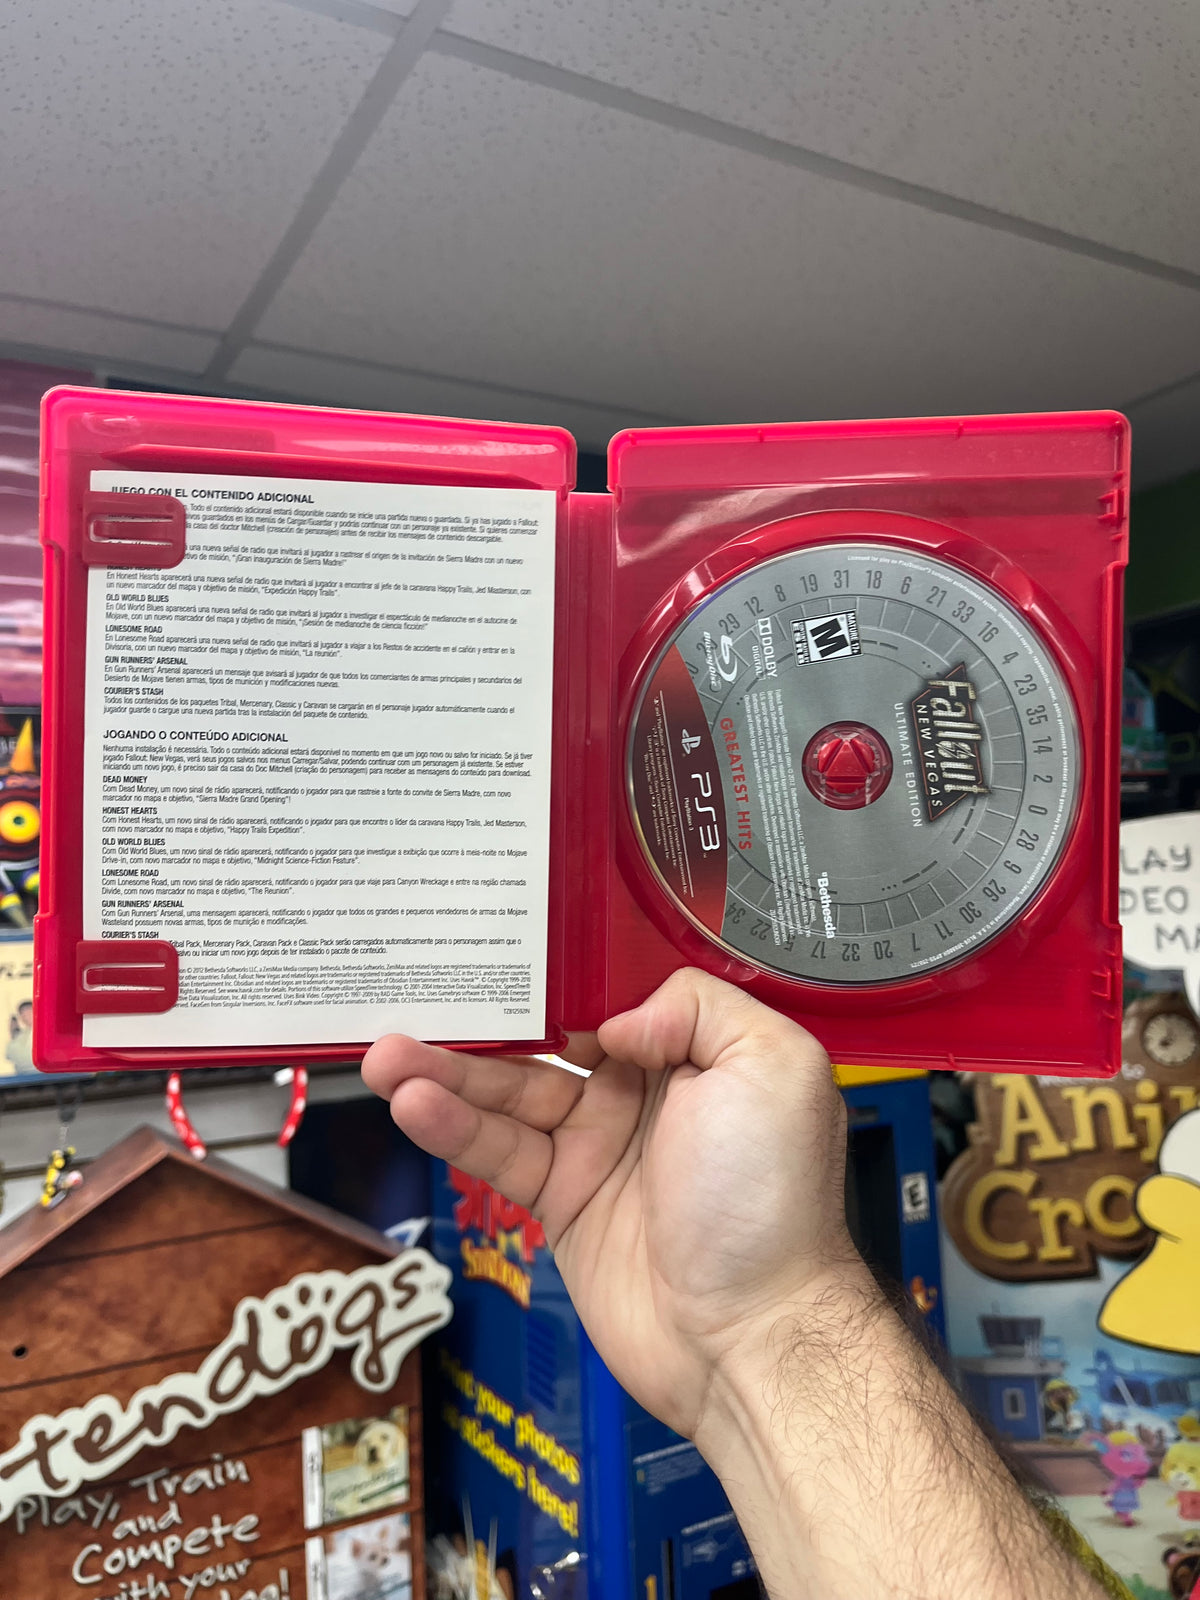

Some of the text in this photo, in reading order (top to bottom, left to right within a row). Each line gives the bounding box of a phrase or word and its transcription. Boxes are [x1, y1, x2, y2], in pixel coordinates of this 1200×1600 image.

[110, 486, 315, 504] JUEGO CON EL CONTENIDO ADICIONAL
[800, 573, 819, 594] 19
[833, 569, 850, 589] 31
[865, 570, 883, 590] 18
[900, 576, 912, 595] 6
[105, 593, 169, 603] OLD WORLD BLUES
[774, 584, 787, 602] 8
[926, 585, 948, 608] 21
[743, 596, 764, 617] 12
[952, 600, 975, 624] 33
[104, 624, 163, 634] LONESOME ROAD
[718, 612, 741, 635] 29
[846, 612, 861, 654] MATURE 17+
[978, 621, 999, 643] 16
[809, 617, 849, 658] M
[104, 655, 119, 664] GUN
[155, 657, 188, 666] ARSENAL
[751, 645, 762, 676] DIGITAL
[761, 636, 777, 678] DOLBY
[1002, 651, 1019, 665] 4
[104, 674, 130, 683] Desierto
[141, 674, 164, 685] Mojave
[164, 676, 185, 684] tienen
[185, 677, 207, 685] armas,
[208, 677, 224, 686] tipos
[269, 678, 315, 688] modificaciones
[316, 681, 339, 689] nuevas.
[141, 687, 164, 696] STASH
[1013, 674, 1037, 696] 23
[1026, 705, 1049, 726] 35
[102, 729, 289, 742] JOGANDO O CONTEÚDO ADICIONAL
[928, 680, 991, 794] Fallout
[1032, 736, 1053, 755] 14
[893, 702, 923, 828] ULTIMATE EDITION
[916, 704, 942, 807] NEW VEGAS
[102, 775, 148, 784] DEAD MONEY
[720, 717, 752, 850] GREATEST HITS
[1032, 774, 1053, 784] 2
[101, 794, 132, 802] marcador
[143, 795, 161, 803] mapa
[167, 795, 195, 804] objetivo,
[218, 794, 239, 803] Madre
[239, 795, 259, 804] Grand
[101, 806, 158, 815] HONEST HEARTS
[683, 797, 692, 826] PlayStation
[691, 772, 721, 851] PS3
[1028, 804, 1048, 816] 0
[101, 837, 166, 847] OLD WORLD BLUES
[1015, 828, 1040, 851] 28
[1003, 860, 1022, 874] 9
[1120, 846, 1191, 874] LAY
[101, 868, 159, 877] LONESOME ROAD
[101, 886, 122, 896] Divide,
[155, 888, 186, 896] marcador
[195, 888, 214, 897] mapa
[220, 888, 247, 897] objetivo,
[982, 878, 1007, 903] 26
[1120, 886, 1188, 914] DEO
[101, 900, 116, 908] GUN
[152, 900, 184, 909] ARSENAL
[817, 877, 837, 939] Bethesda
[958, 901, 982, 925] 30
[101, 918, 133, 926] Wasteland
[134, 919, 163, 927] possuem
[206, 918, 223, 927] tipos
[750, 918, 773, 941] 22
[934, 920, 954, 941] 11
[137, 931, 159, 939] STASH
[911, 932, 921, 952] 7
[810, 940, 827, 959] 17
[841, 942, 861, 962] 32
[873, 940, 894, 960] 20
[991, 1074, 1200, 1166] Ani
[909, 1182, 922, 1208] E
[965, 1169, 1143, 1262] Cro
[129, 1453, 250, 1503] Train
[112, 1501, 183, 1540] and
[72, 1513, 261, 1585] Compete
[179, 1558, 251, 1600] your
